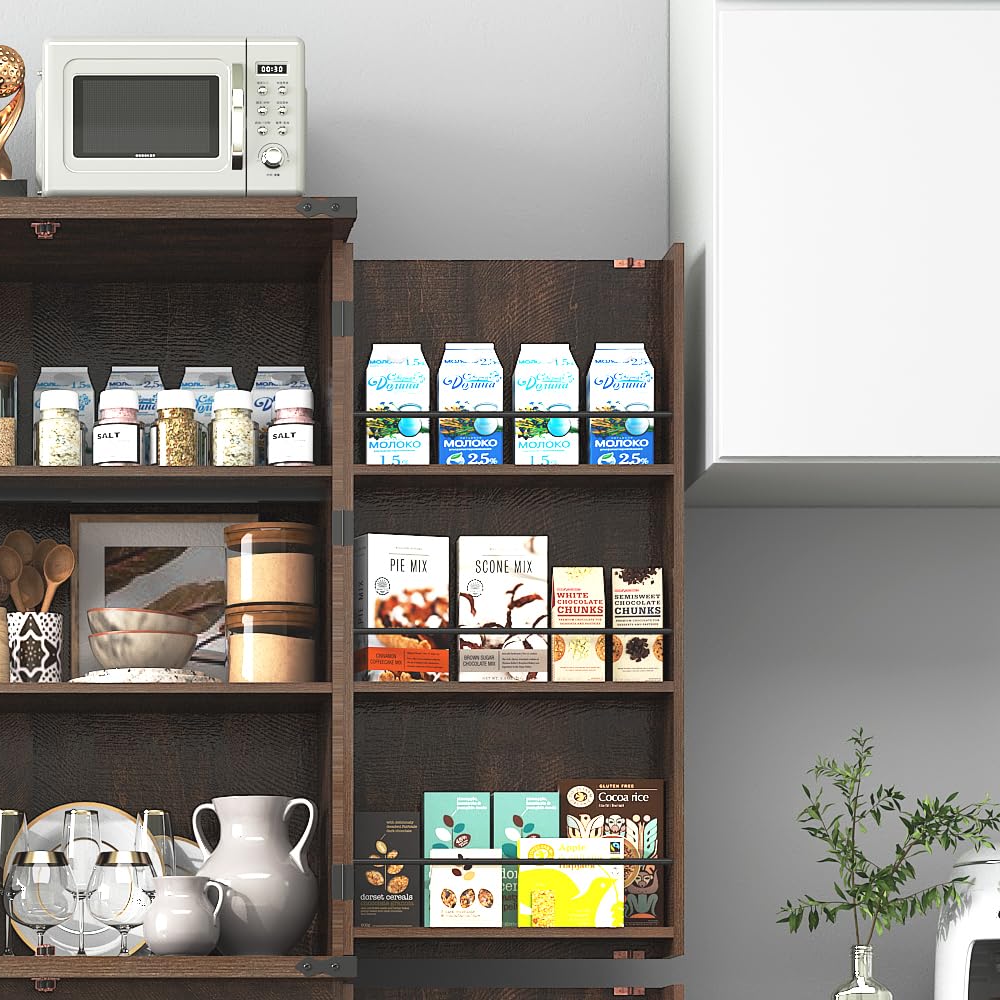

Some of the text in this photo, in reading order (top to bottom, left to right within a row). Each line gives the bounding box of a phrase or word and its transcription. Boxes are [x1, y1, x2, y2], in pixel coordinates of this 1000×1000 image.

[369, 440, 421, 449] МОЛОКО
[443, 439, 498, 448] МОЛОКО
[518, 440, 571, 449] МОЛОКО
[594, 439, 649, 448] МОЛОКО
[390, 558, 428, 573] PIE MIX
[475, 559, 533, 574] SCONE MIX
[557, 606, 604, 614] CHUNKS
[614, 607, 661, 615] CHUNKS
[598, 791, 650, 802] Cocoa rice
[360, 893, 414, 901] dorset cereals
